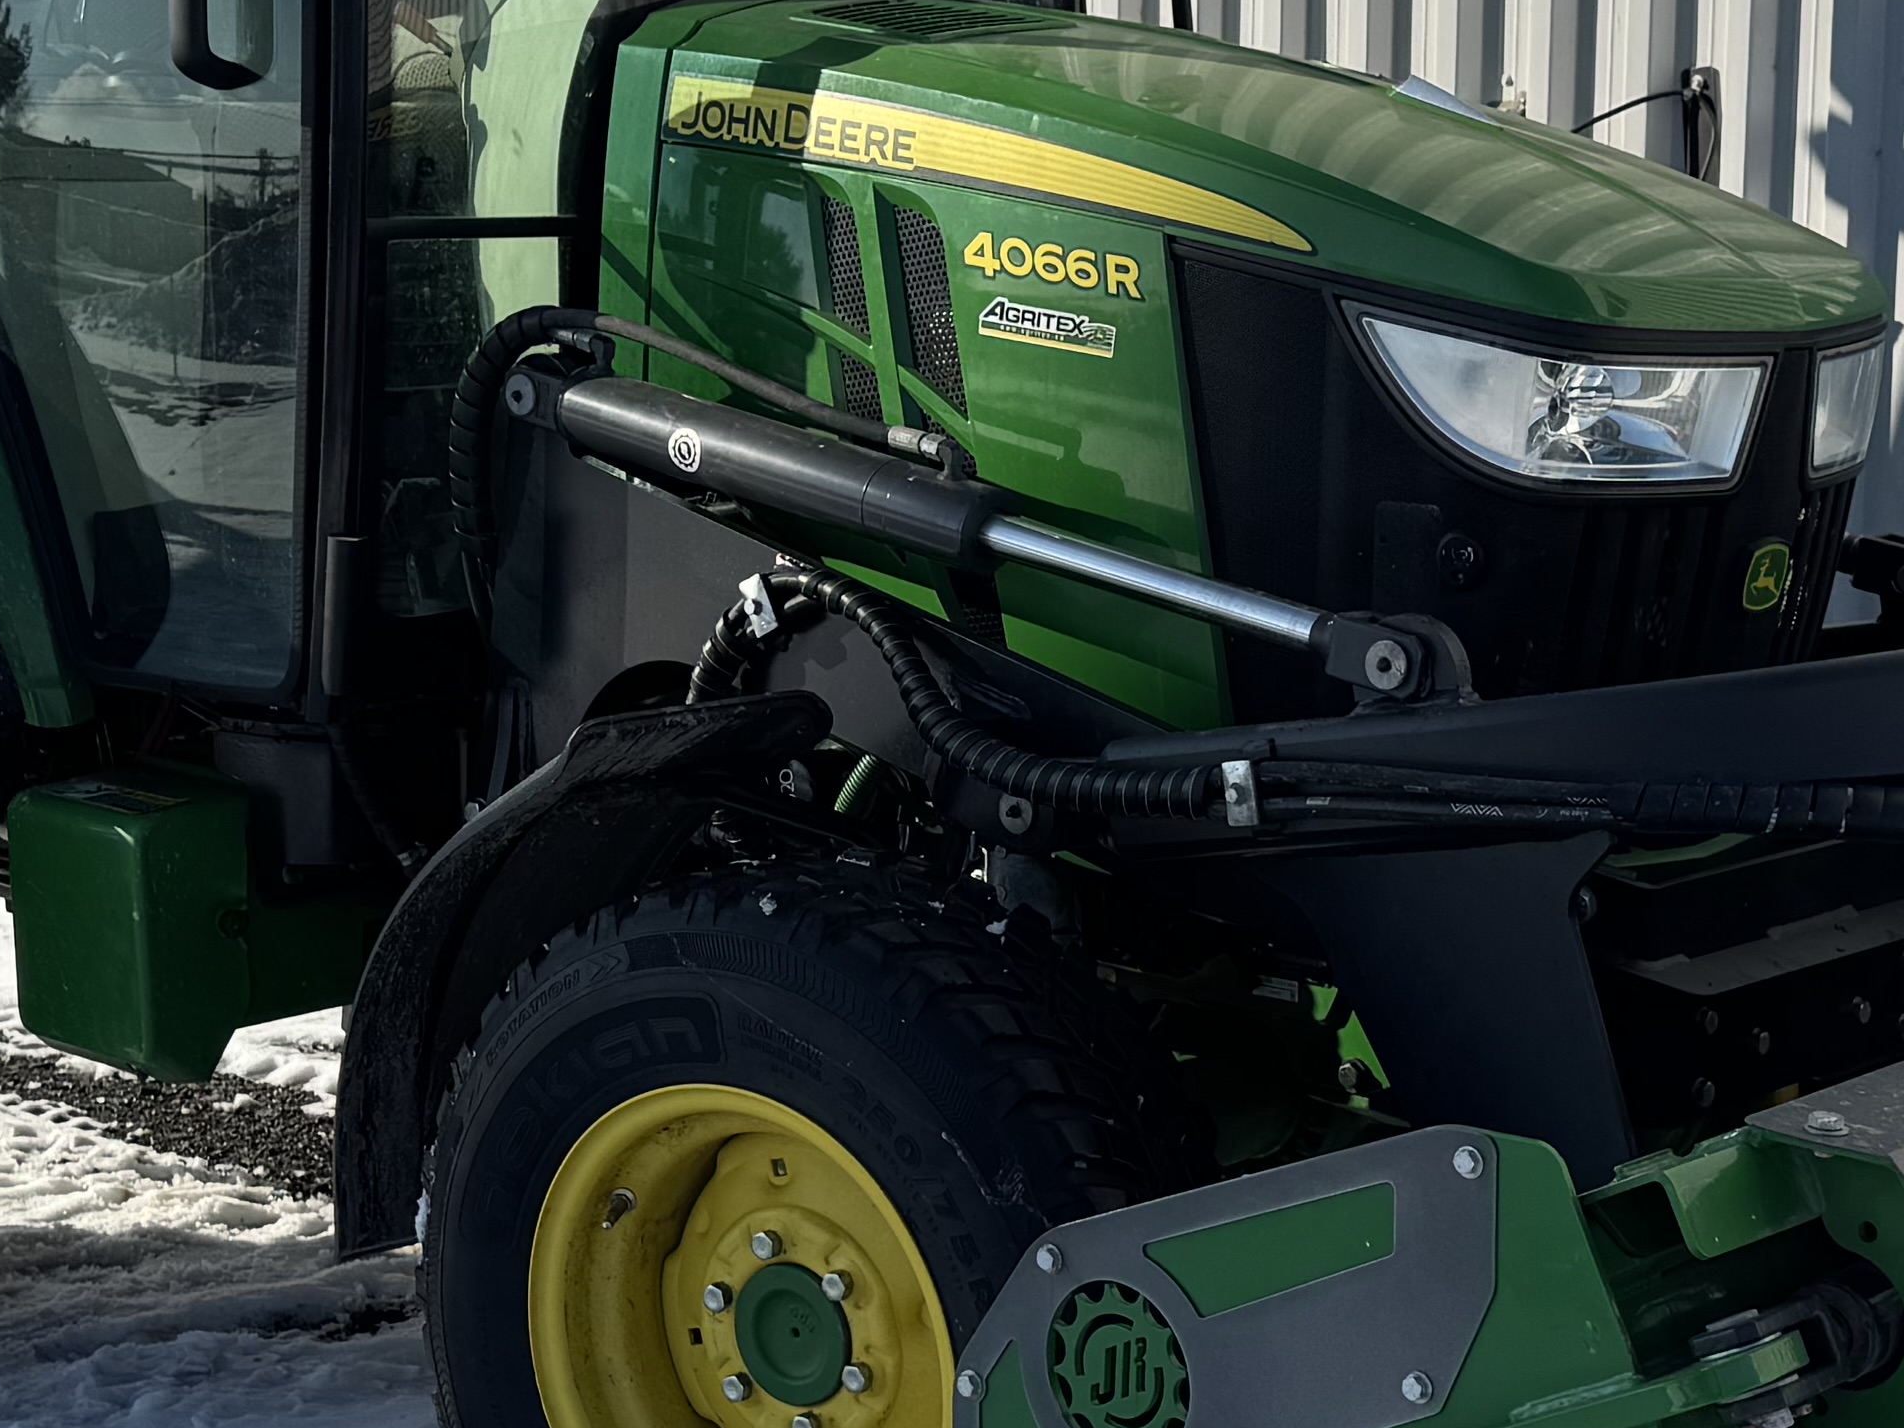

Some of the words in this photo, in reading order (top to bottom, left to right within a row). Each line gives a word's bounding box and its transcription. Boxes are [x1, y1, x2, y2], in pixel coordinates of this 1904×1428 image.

[681, 90, 779, 143] JOHN
[783, 102, 918, 167] DEERE
[983, 300, 1086, 335] AGRITEX
[485, 968, 581, 1068] ROTATION
